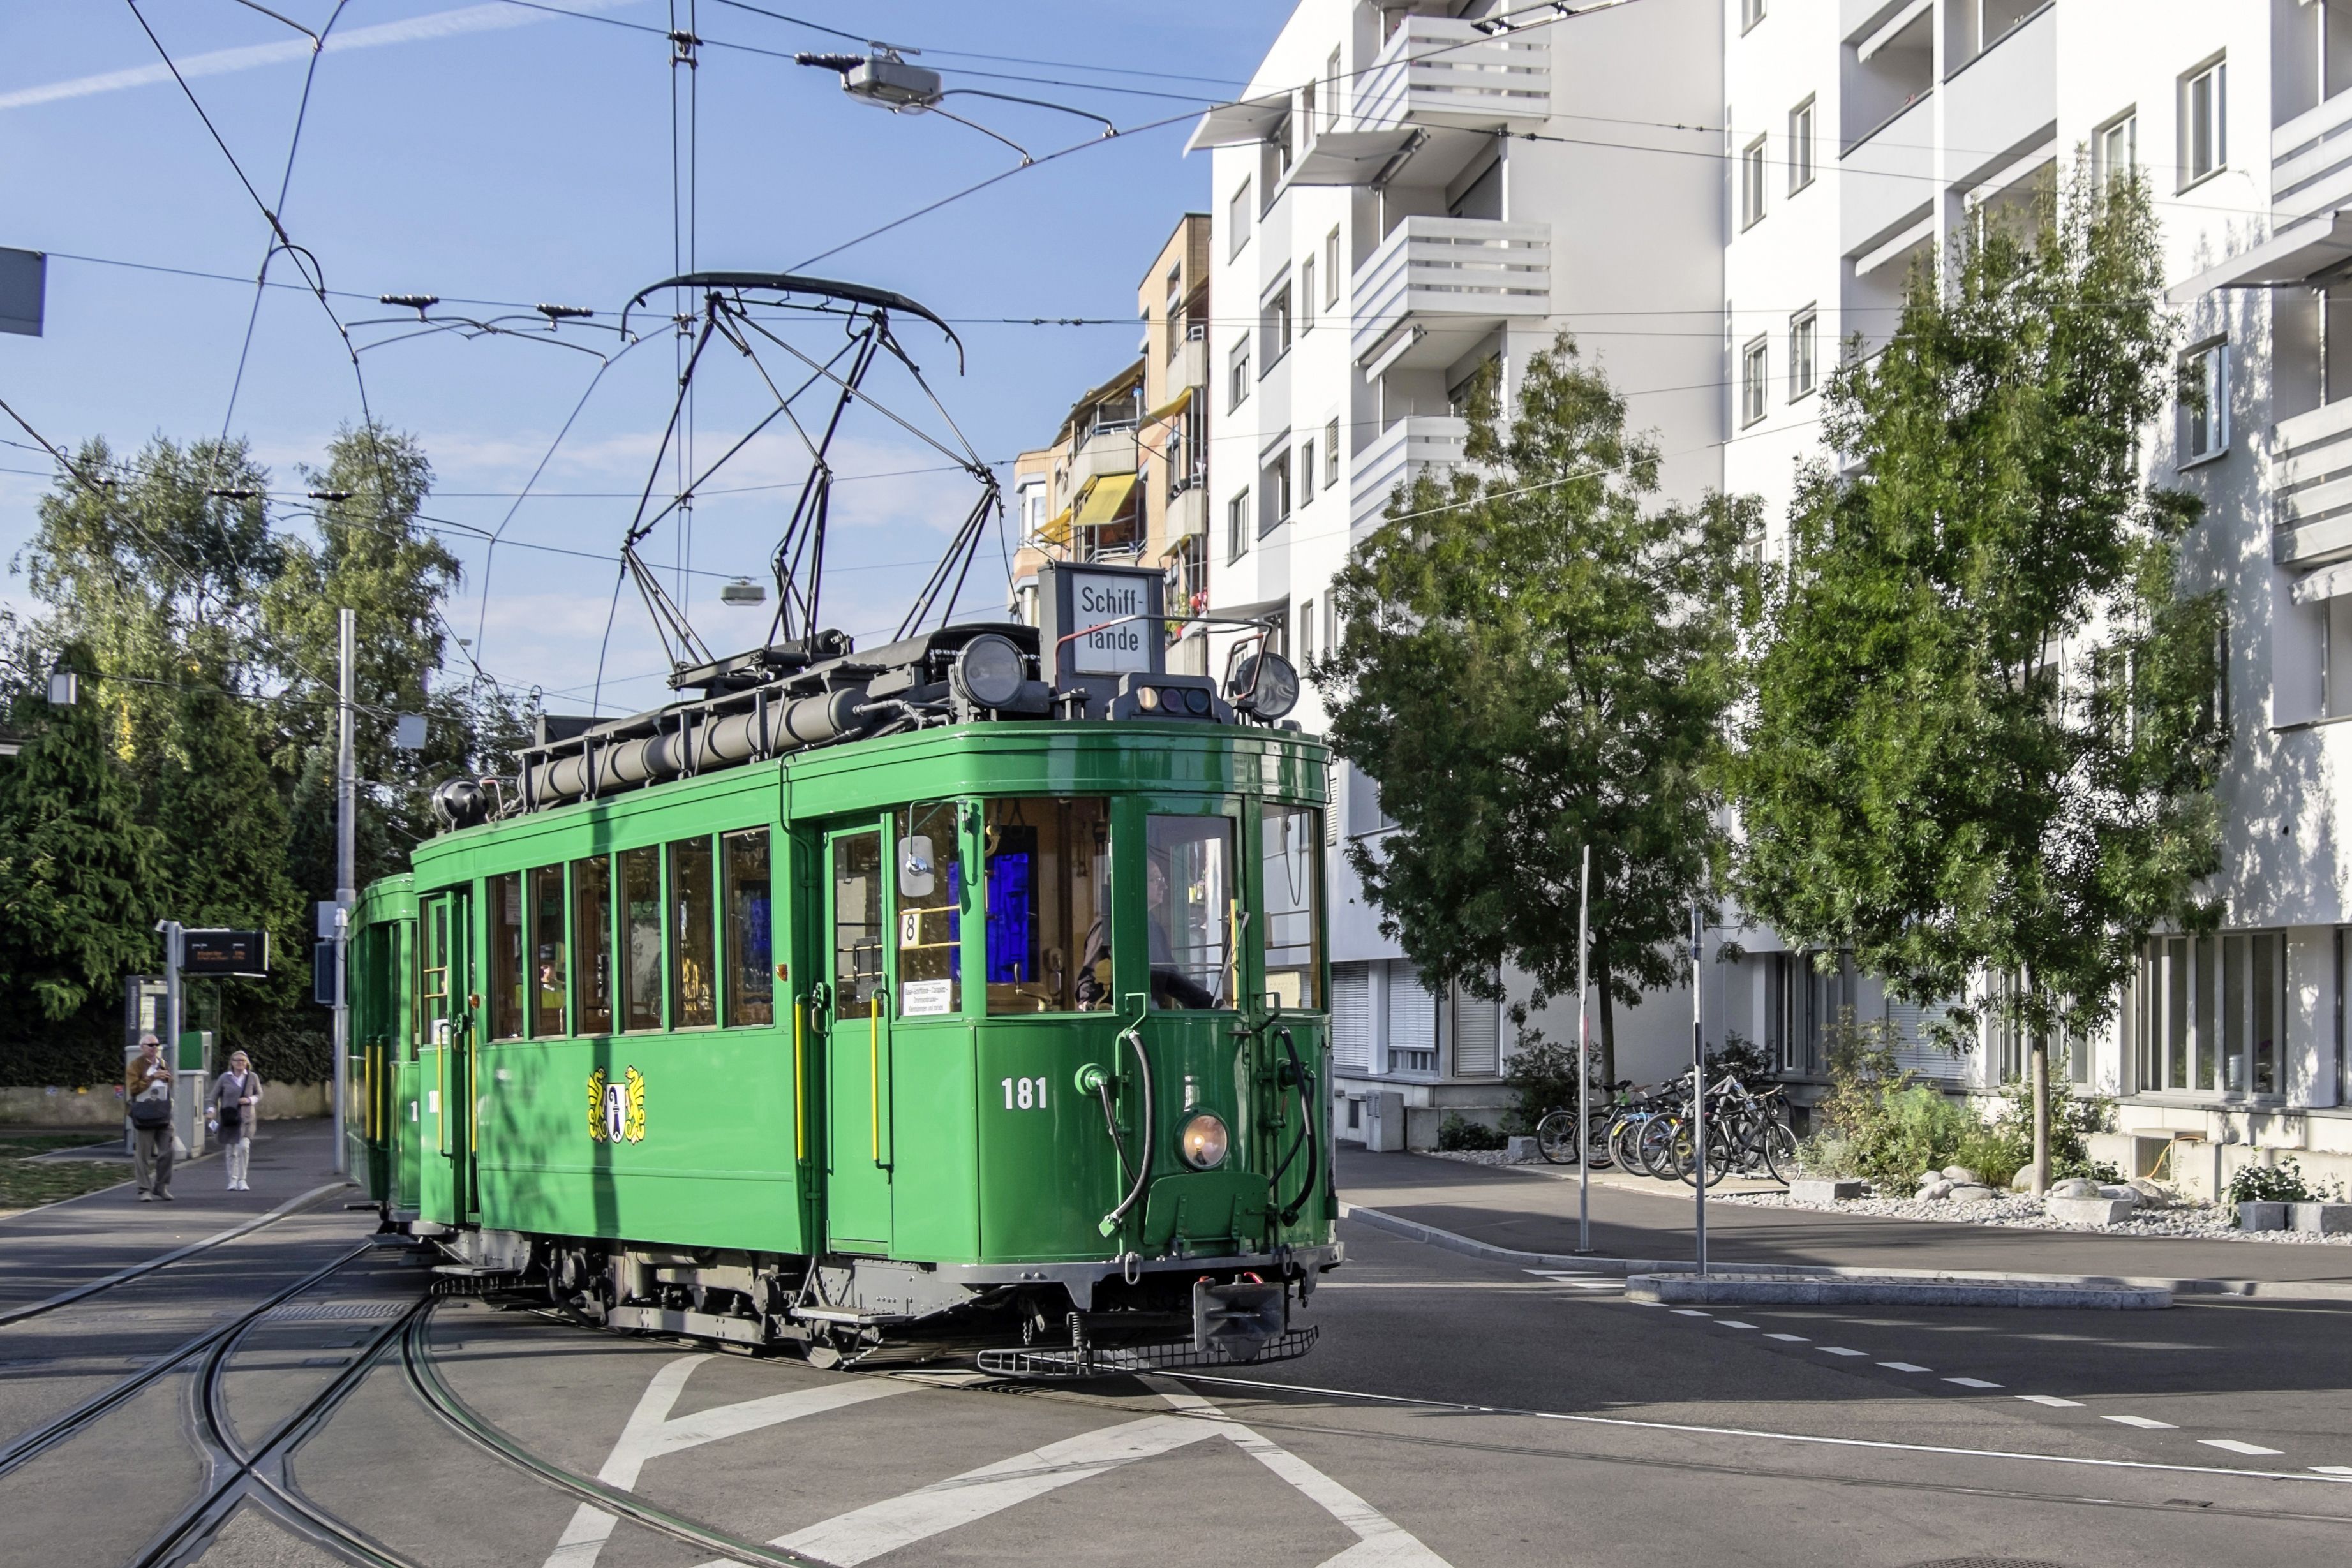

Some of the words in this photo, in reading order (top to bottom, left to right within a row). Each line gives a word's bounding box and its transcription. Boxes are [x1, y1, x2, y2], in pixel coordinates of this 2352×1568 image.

[1082, 586, 1143, 616] Schiff-
[906, 913, 914, 941] 8
[1001, 1076, 1046, 1109] 181
